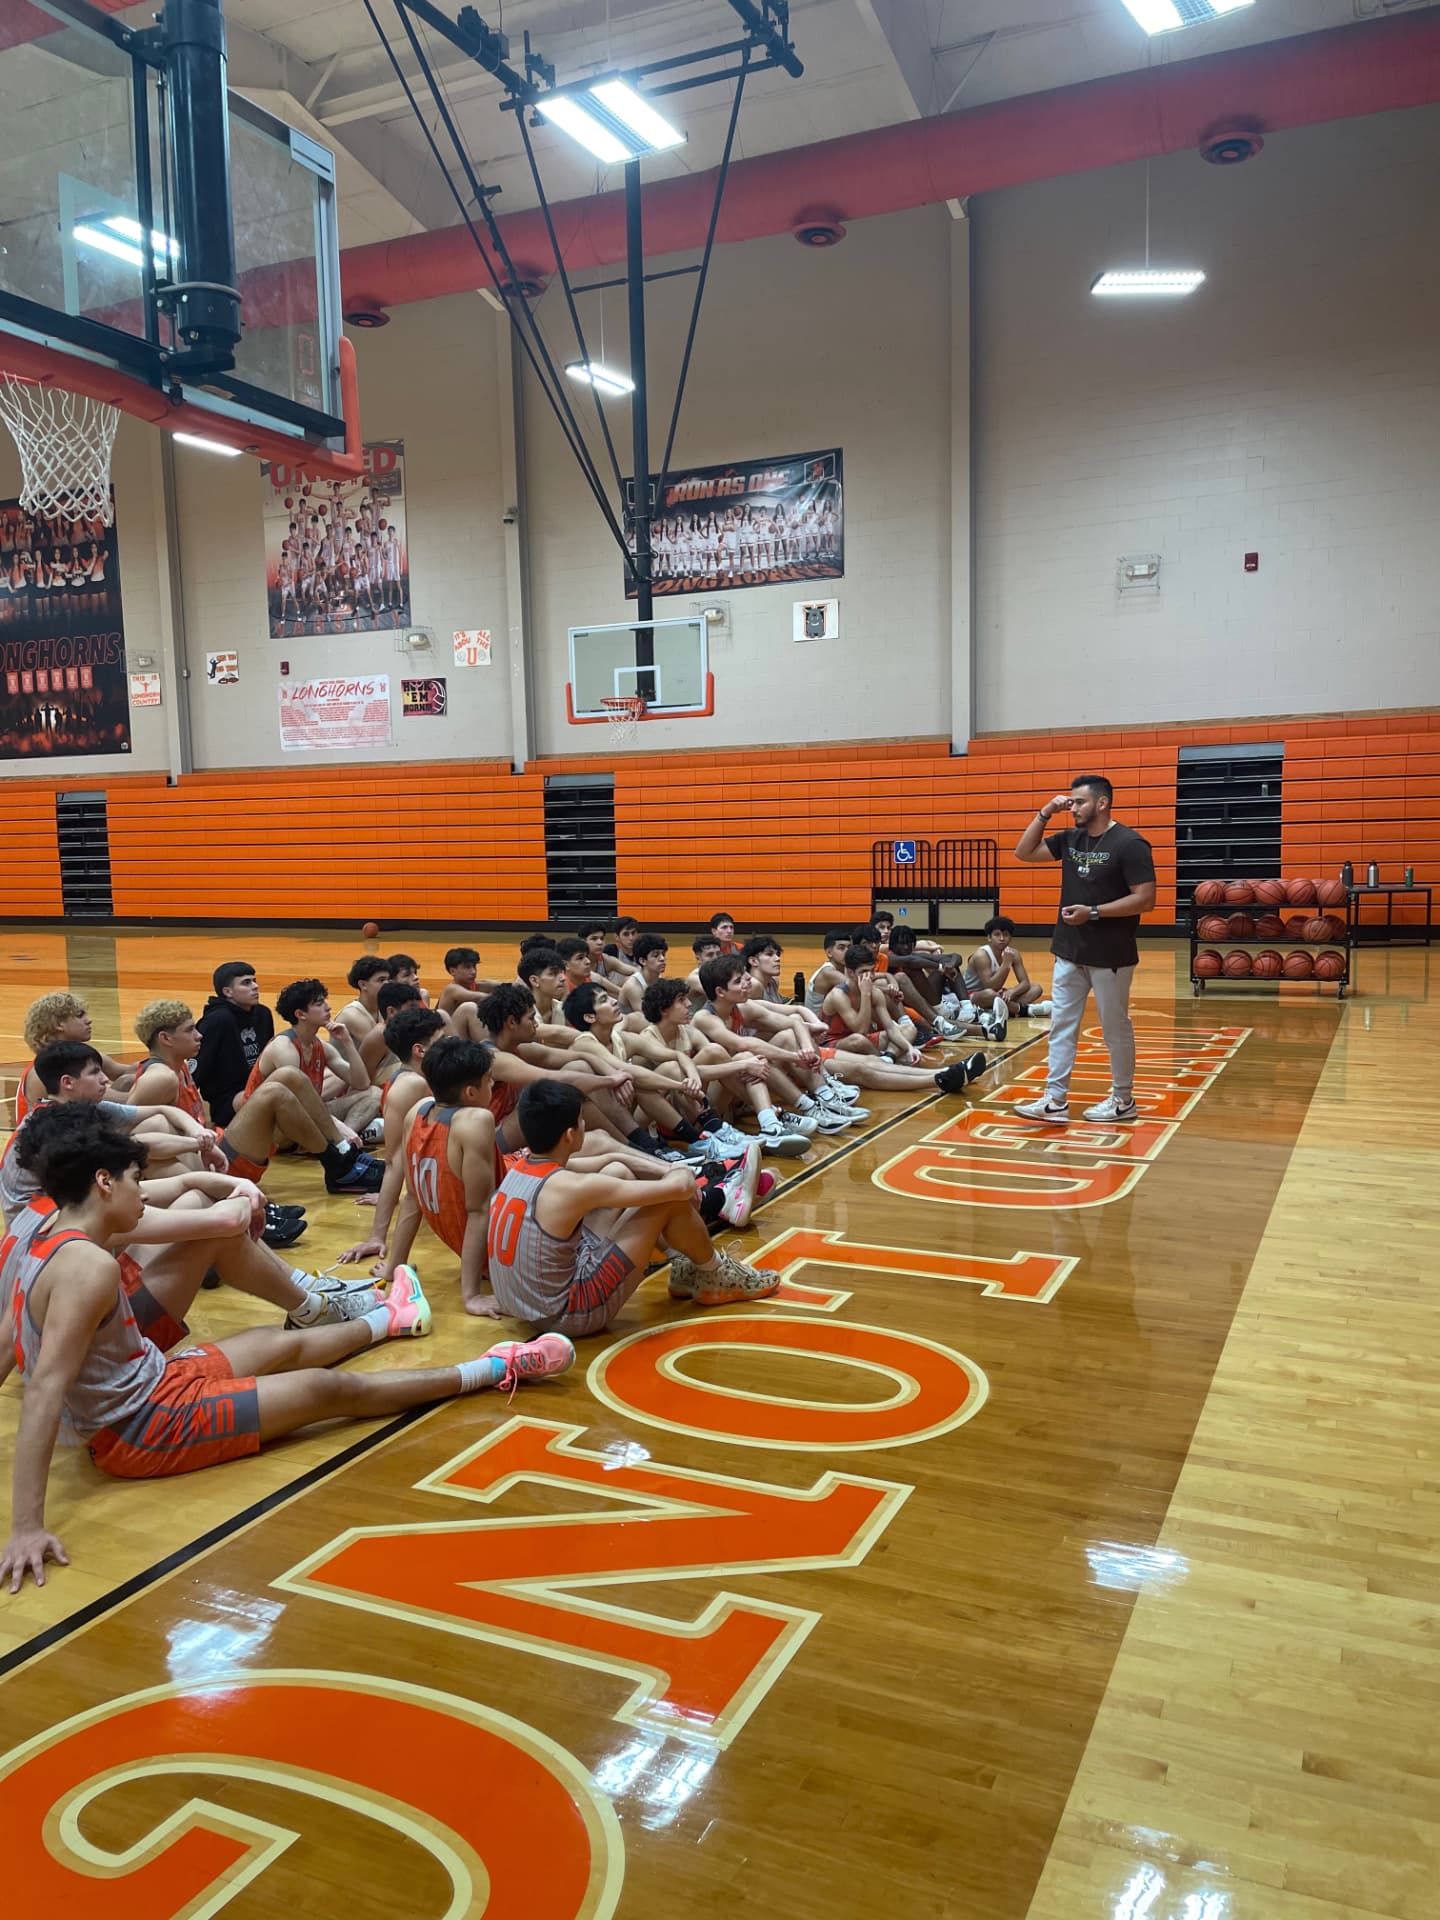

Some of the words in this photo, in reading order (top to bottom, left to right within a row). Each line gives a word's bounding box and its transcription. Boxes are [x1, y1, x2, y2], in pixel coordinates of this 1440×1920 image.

[717, 476, 745, 496] AS
[749, 470, 790, 490] ONE
[467, 647, 477, 665] U
[292, 681, 375, 700] LONGHORNS
[412, 1152, 440, 1215] 10
